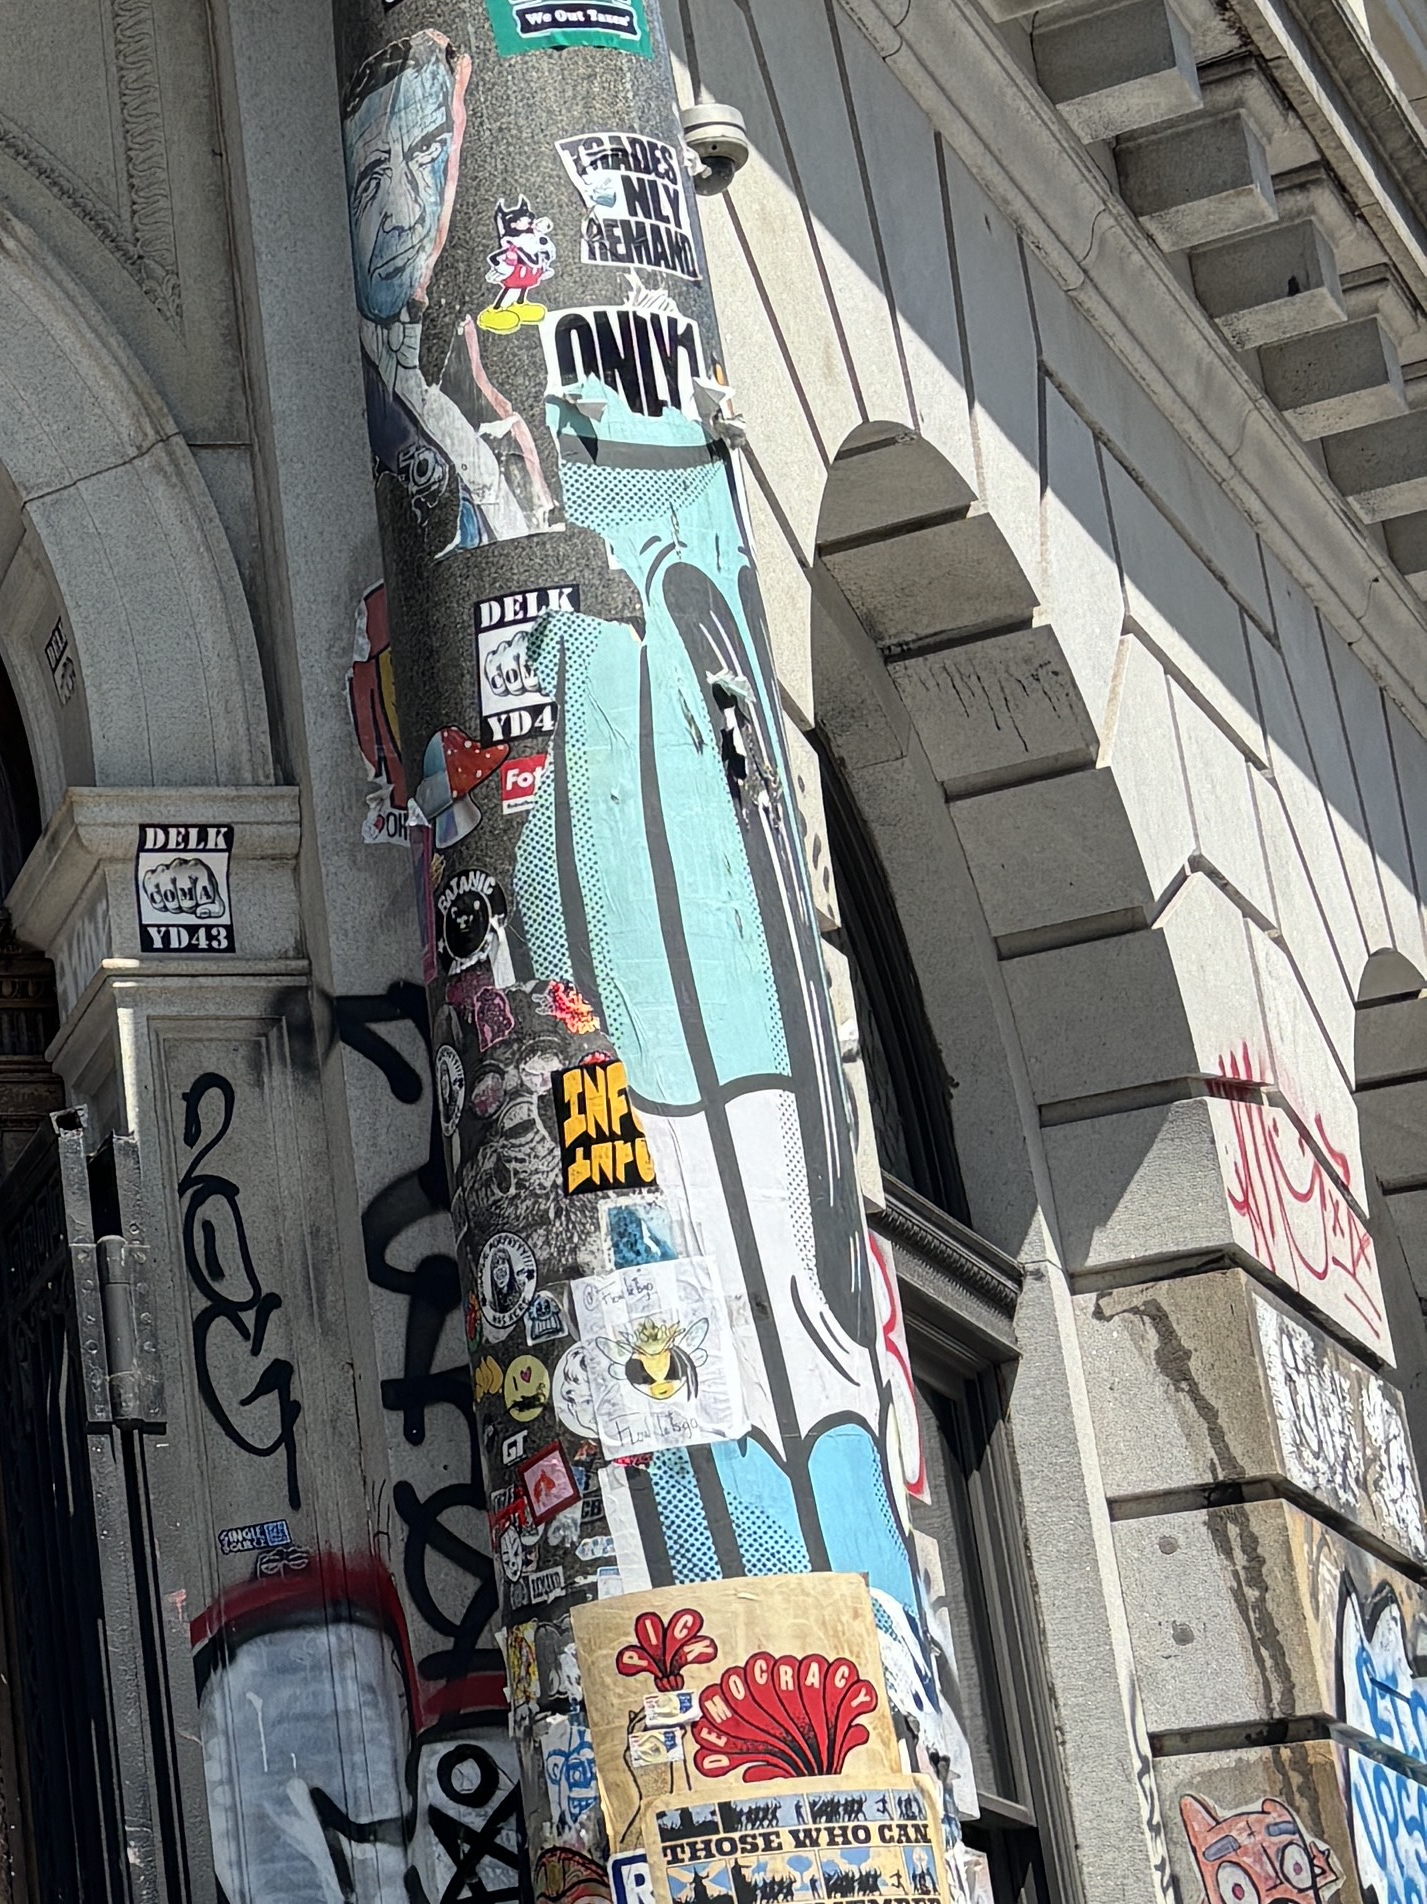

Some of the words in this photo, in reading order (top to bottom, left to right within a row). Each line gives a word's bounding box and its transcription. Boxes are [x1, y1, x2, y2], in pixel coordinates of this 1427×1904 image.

[525, 11, 552, 26] We
[554, 10, 585, 23] Out
[619, 173, 683, 230] NLY
[479, 587, 575, 629] DELK
[489, 663, 540, 692] COM
[486, 709, 555, 742] YD4
[144, 827, 228, 850] DELK
[149, 885, 213, 905] COMA
[146, 926, 229, 949] YD43
[622, 1614, 713, 1668] PICK
[701, 1657, 872, 1771] DEMOCRACY
[662, 1829, 783, 1866] THOSE
[788, 1825, 872, 1852] WHO
[878, 1822, 932, 1846] CAN
